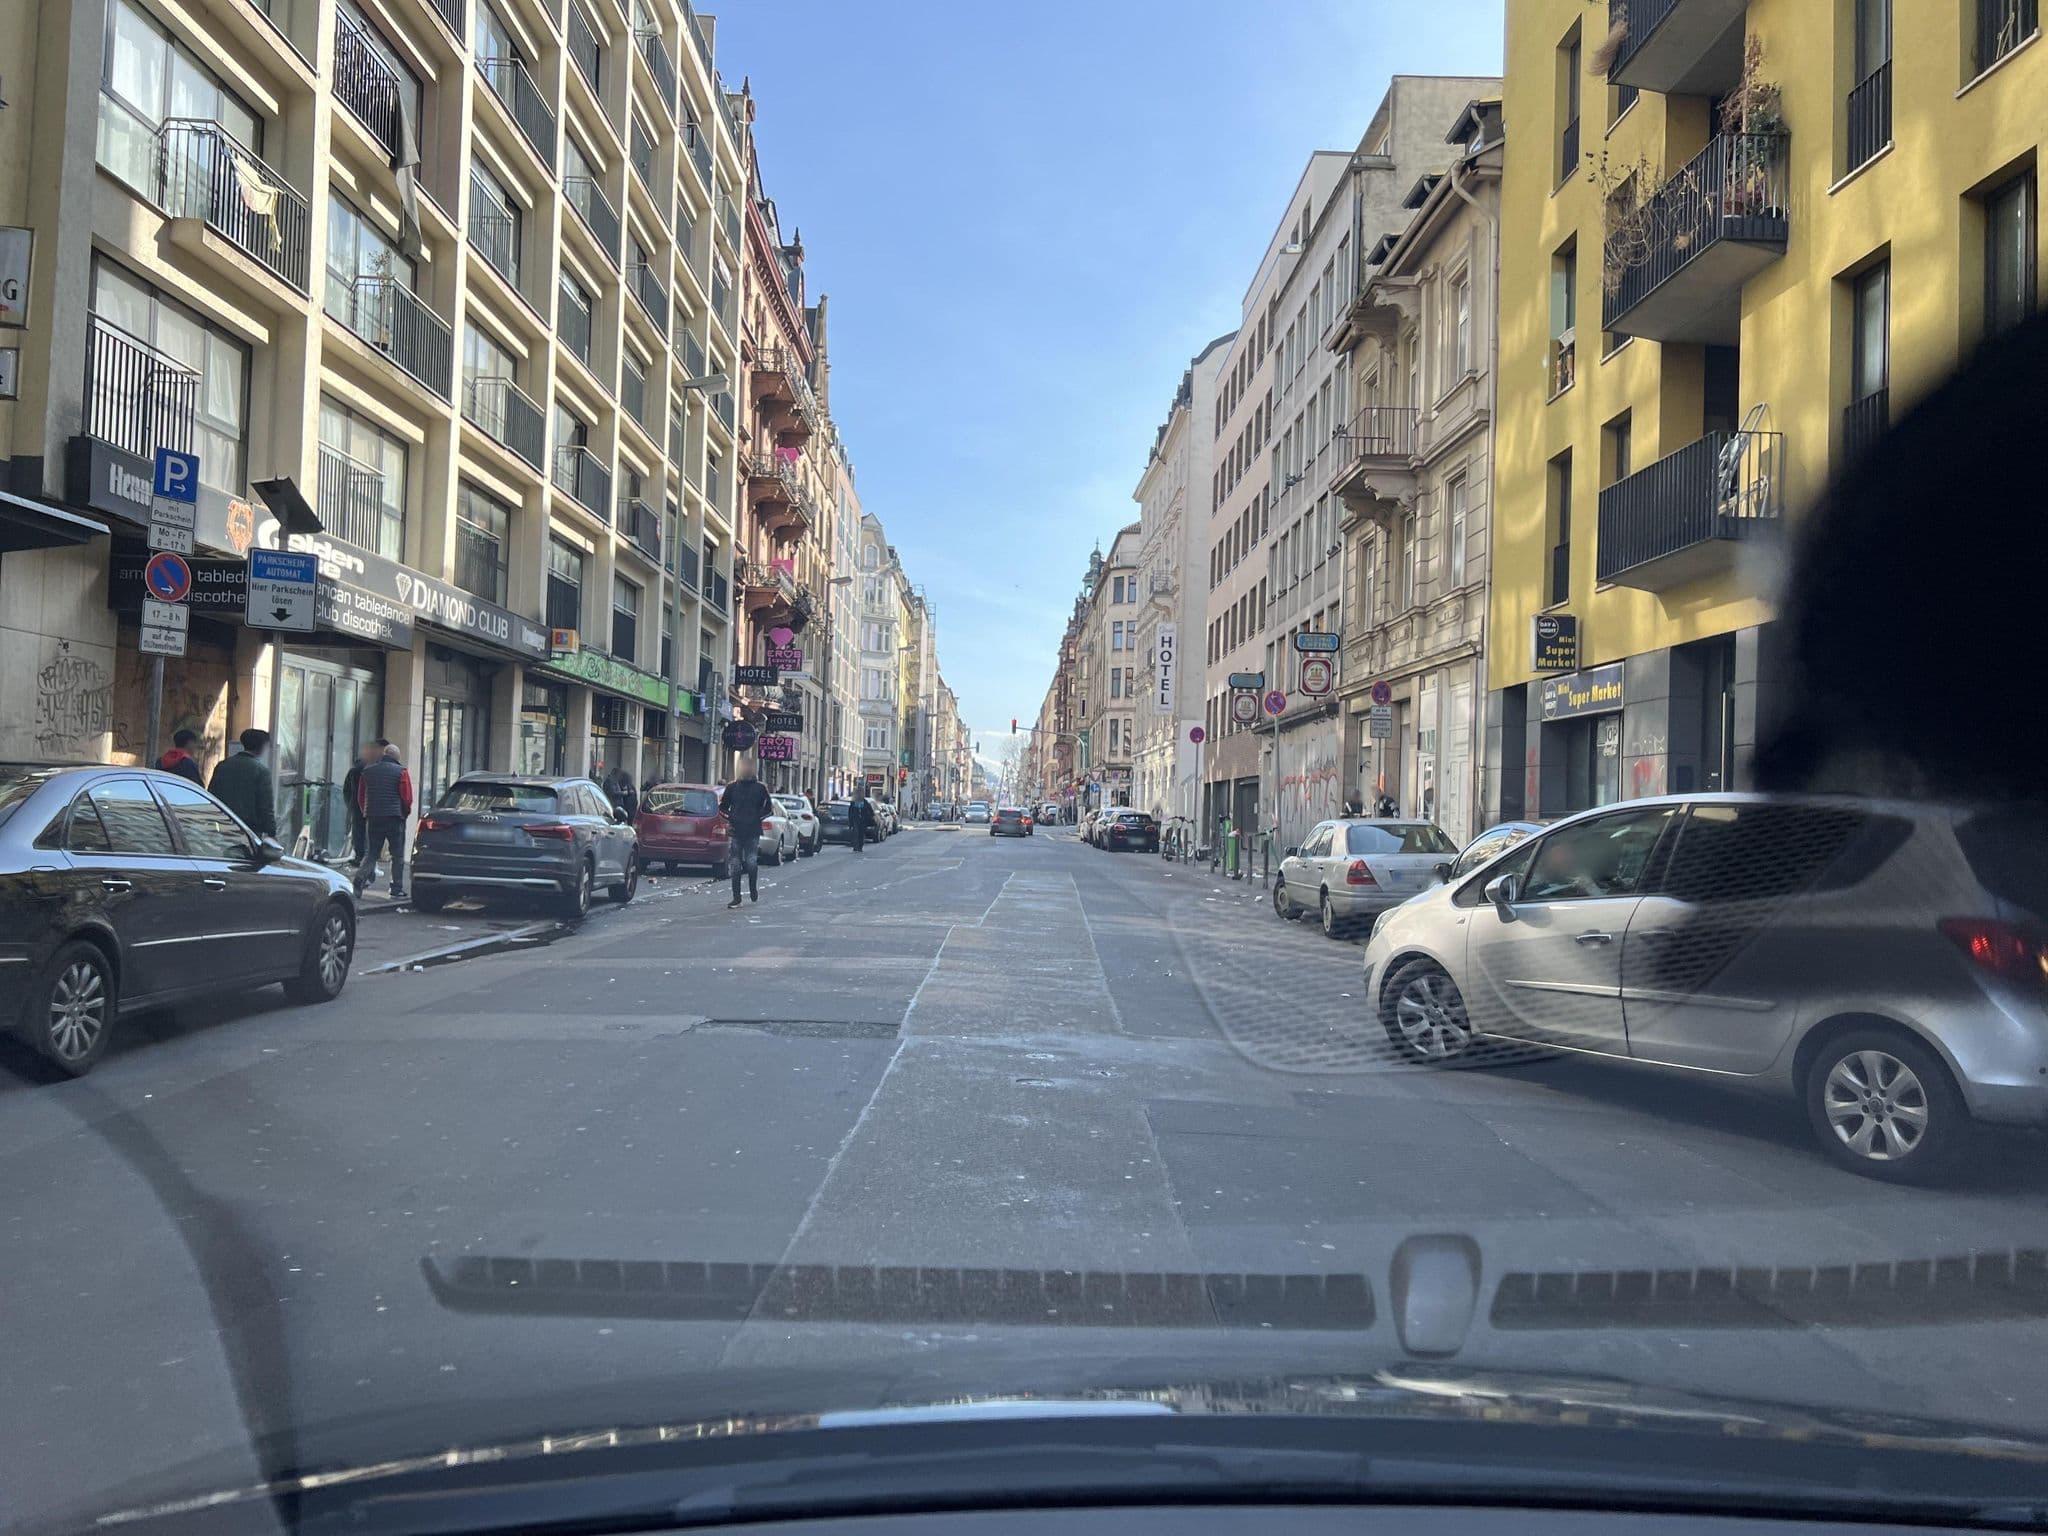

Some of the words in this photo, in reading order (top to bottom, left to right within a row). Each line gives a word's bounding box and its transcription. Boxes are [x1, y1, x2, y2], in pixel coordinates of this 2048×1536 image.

[164, 455, 189, 492] P
[167, 504, 179, 513] mit
[153, 509, 192, 524] Parkschein
[158, 527, 170, 538] Mo
[177, 532, 186, 540] Fr
[170, 540, 179, 549] 17
[180, 543, 186, 551] h
[265, 566, 302, 580] AUTOMAT
[251, 583, 268, 592] Hier
[271, 583, 314, 597] Parkschein
[271, 593, 293, 606] lösen
[412, 577, 476, 627] DIAMOND
[152, 609, 161, 618] 17
[175, 613, 181, 621] h
[354, 592, 411, 626] tabledance
[342, 609, 393, 640] discothek
[478, 610, 508, 640] CLUB
[151, 632, 162, 640] auf
[164, 634, 177, 642] dem
[1558, 636, 1575, 644] Mini
[1546, 645, 1576, 657] Super
[1537, 658, 1575, 668] Market
[740, 669, 772, 679] HOTEL
[1160, 635, 1173, 706] HOTEL
[1558, 681, 1570, 696] Mini
[1568, 690, 1590, 710] Super
[1591, 681, 1621, 703] Market
[770, 717, 799, 726] HOTEL
